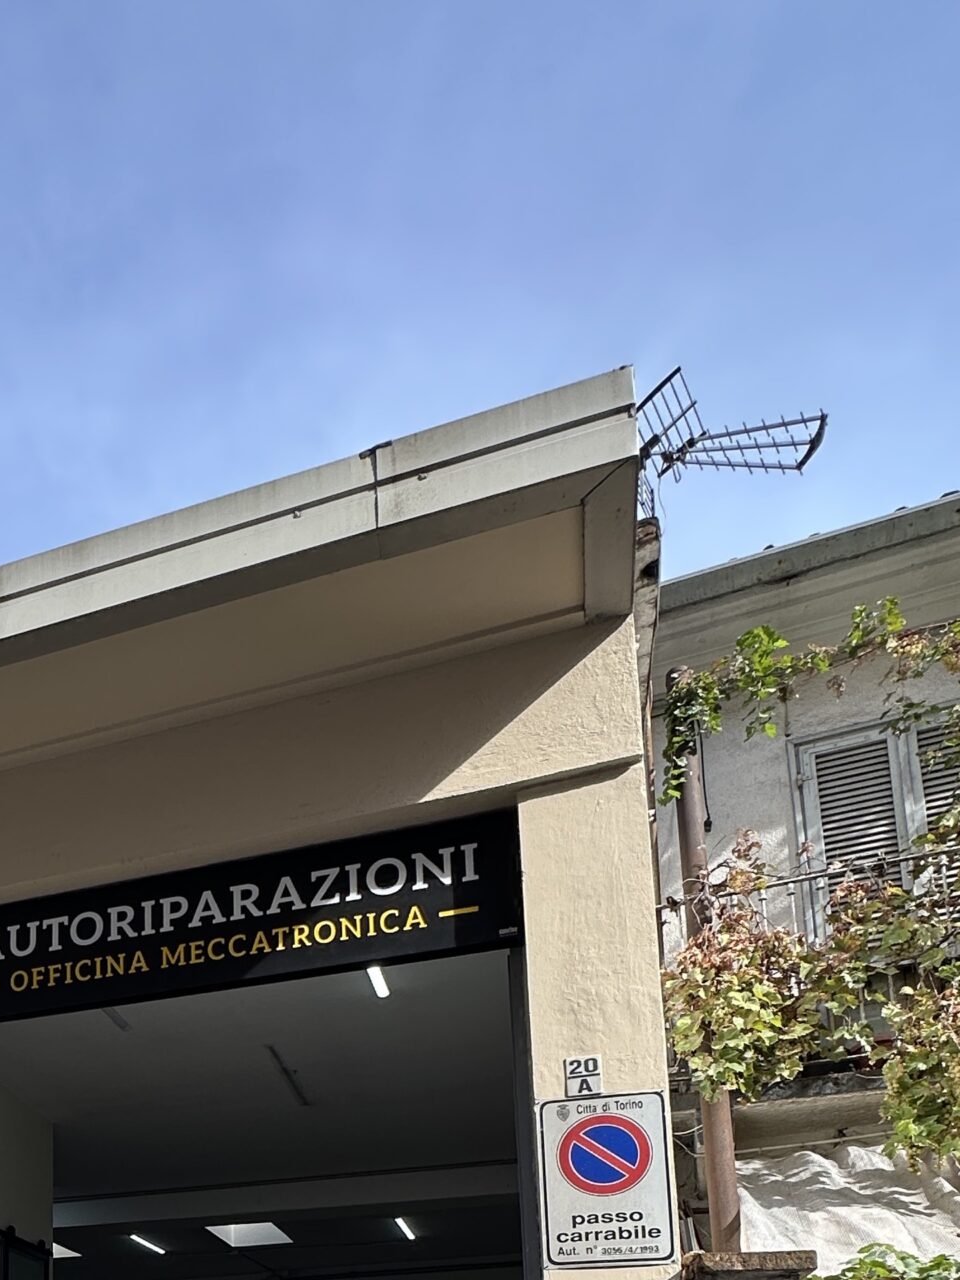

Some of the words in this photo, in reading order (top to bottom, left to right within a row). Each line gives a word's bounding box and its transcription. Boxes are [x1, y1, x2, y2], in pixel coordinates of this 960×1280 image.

[9, 950, 151, 992] OFFICINA
[159, 905, 428, 969] MECCATRONICA
[568, 1058, 598, 1075] 20
[578, 1078, 593, 1093] A
[601, 1102, 611, 1112] di
[614, 1099, 643, 1111] Torino
[571, 1211, 644, 1228] passo
[556, 1225, 662, 1243] carrabile
[557, 1246, 580, 1256] Aut.
